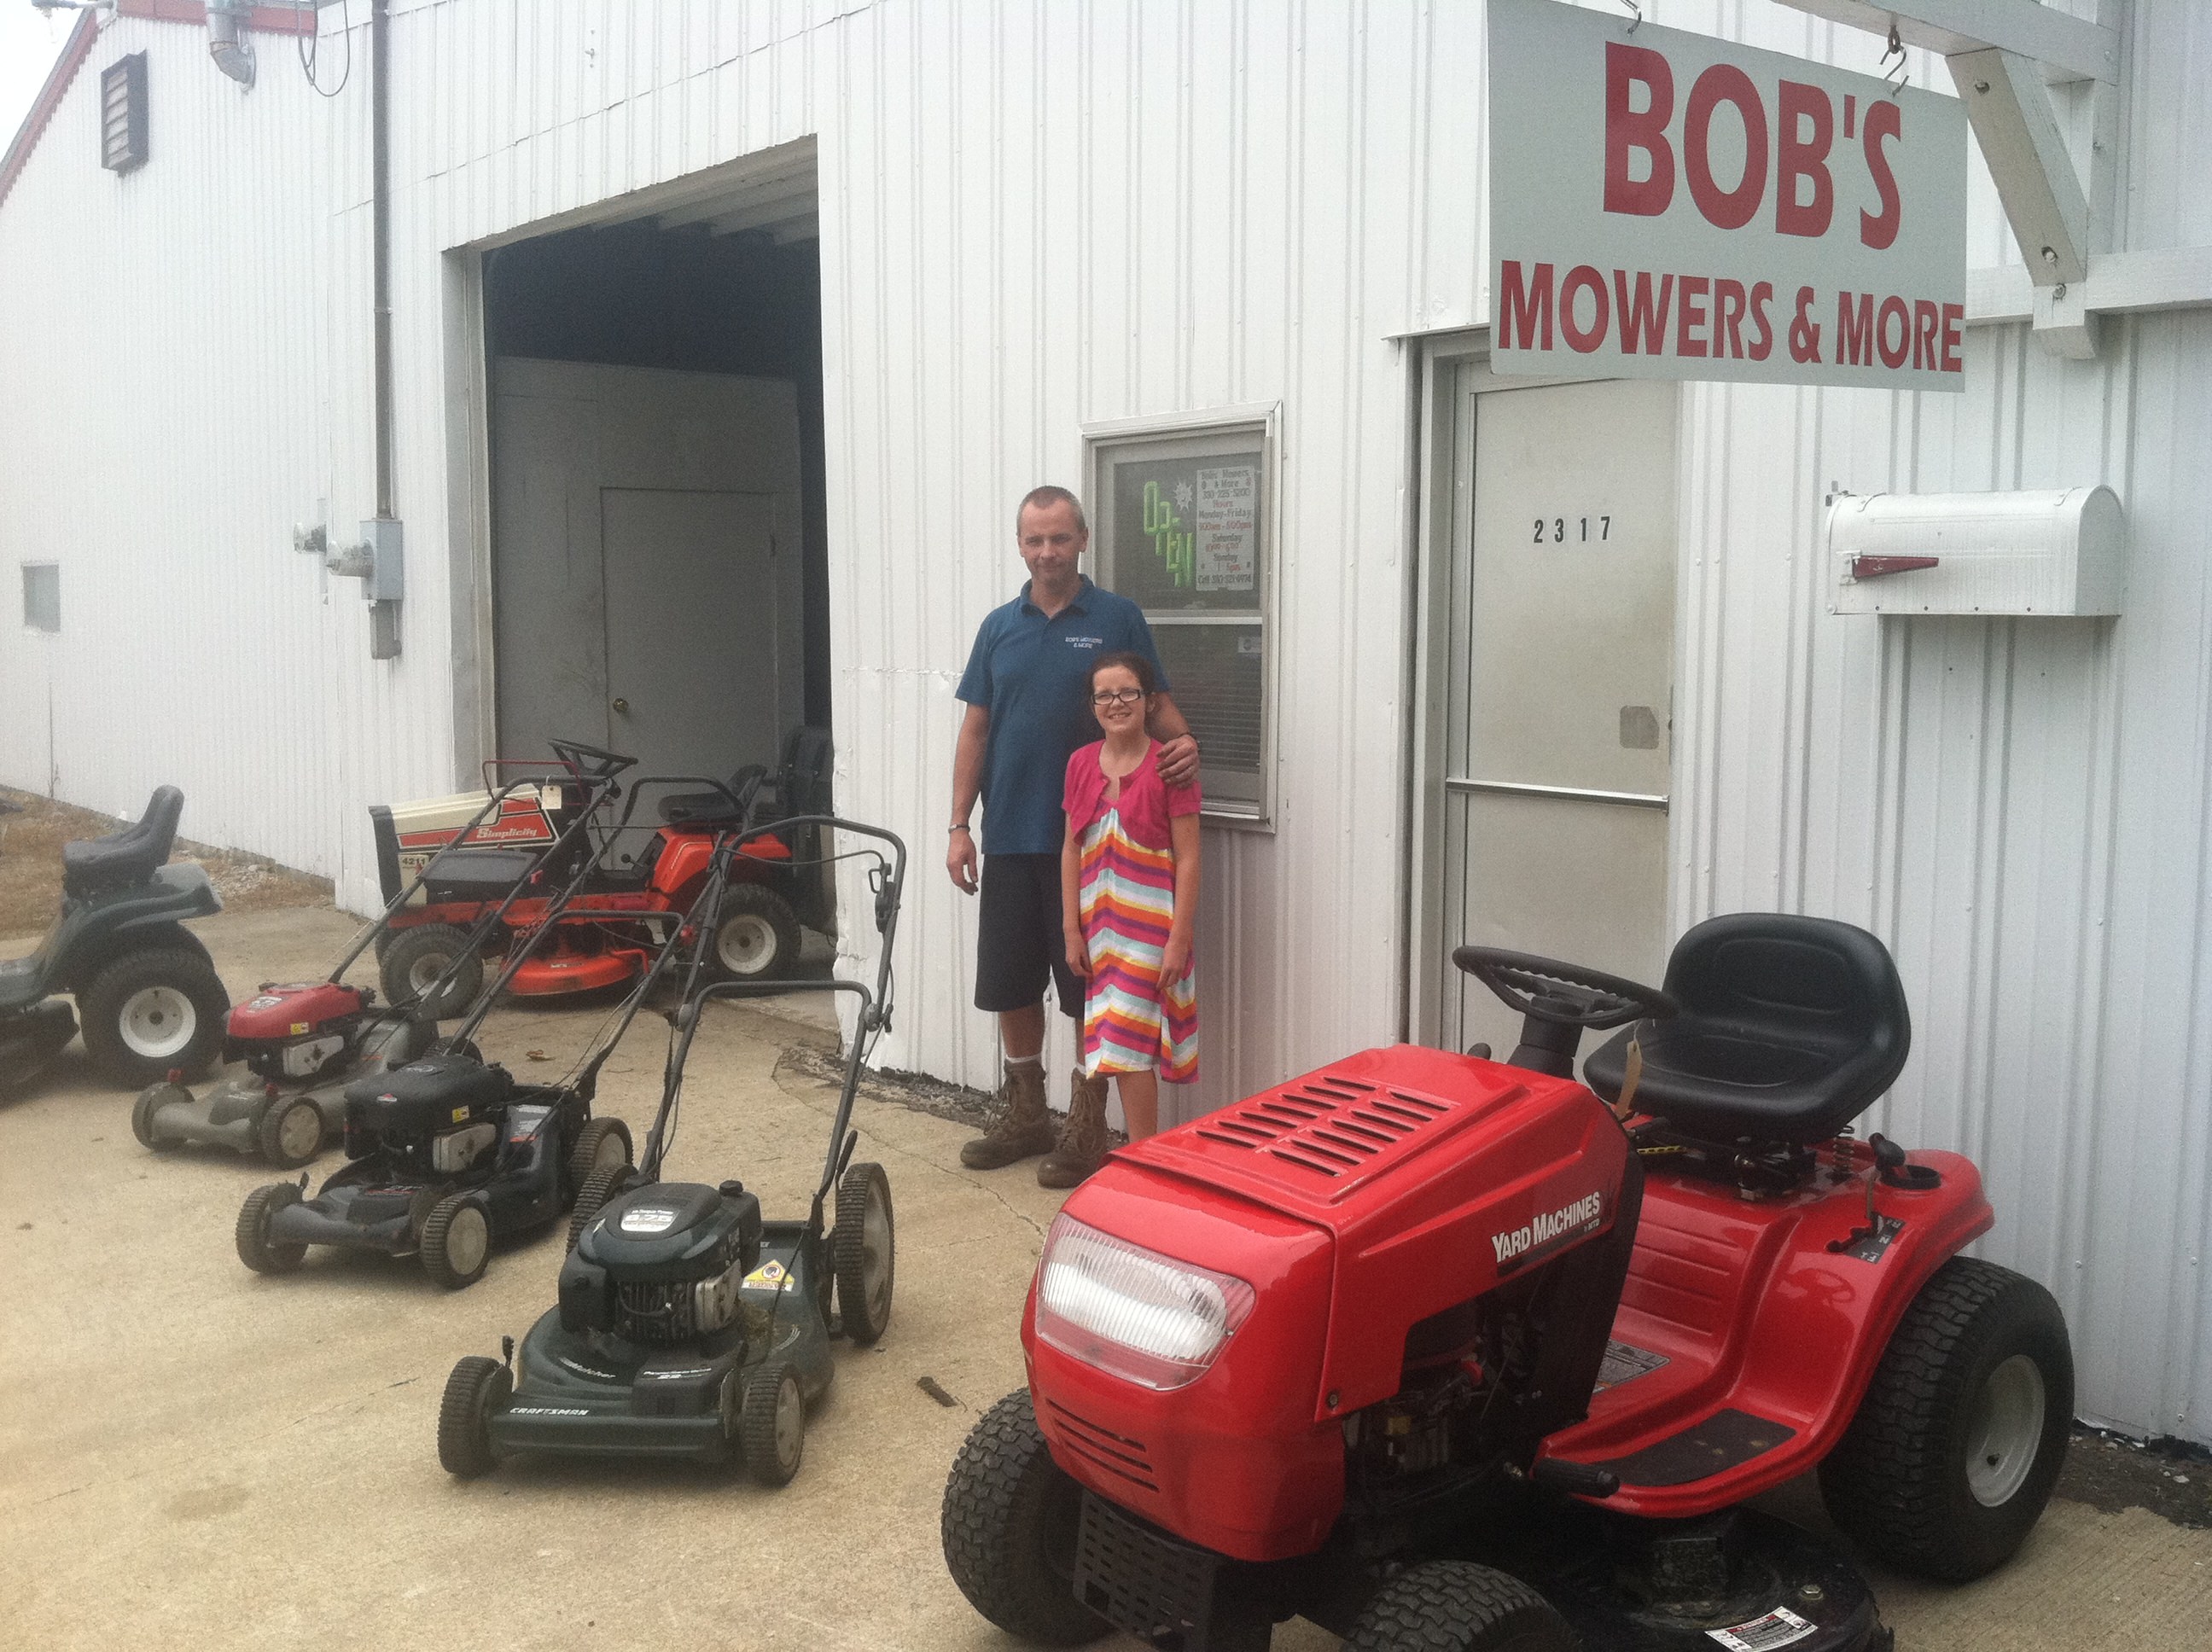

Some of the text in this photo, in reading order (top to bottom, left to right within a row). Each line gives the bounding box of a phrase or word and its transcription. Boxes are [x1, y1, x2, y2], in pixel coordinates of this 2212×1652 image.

[1604, 40, 1901, 250] BOB'S
[1498, 259, 1963, 373] MOWERS & MORE
[1534, 516, 1610, 544] 2317
[477, 828, 537, 840] Simplicity
[1492, 1191, 1600, 1263] YARD MACHINES
[509, 1407, 590, 1416] CRAFTSMAN
